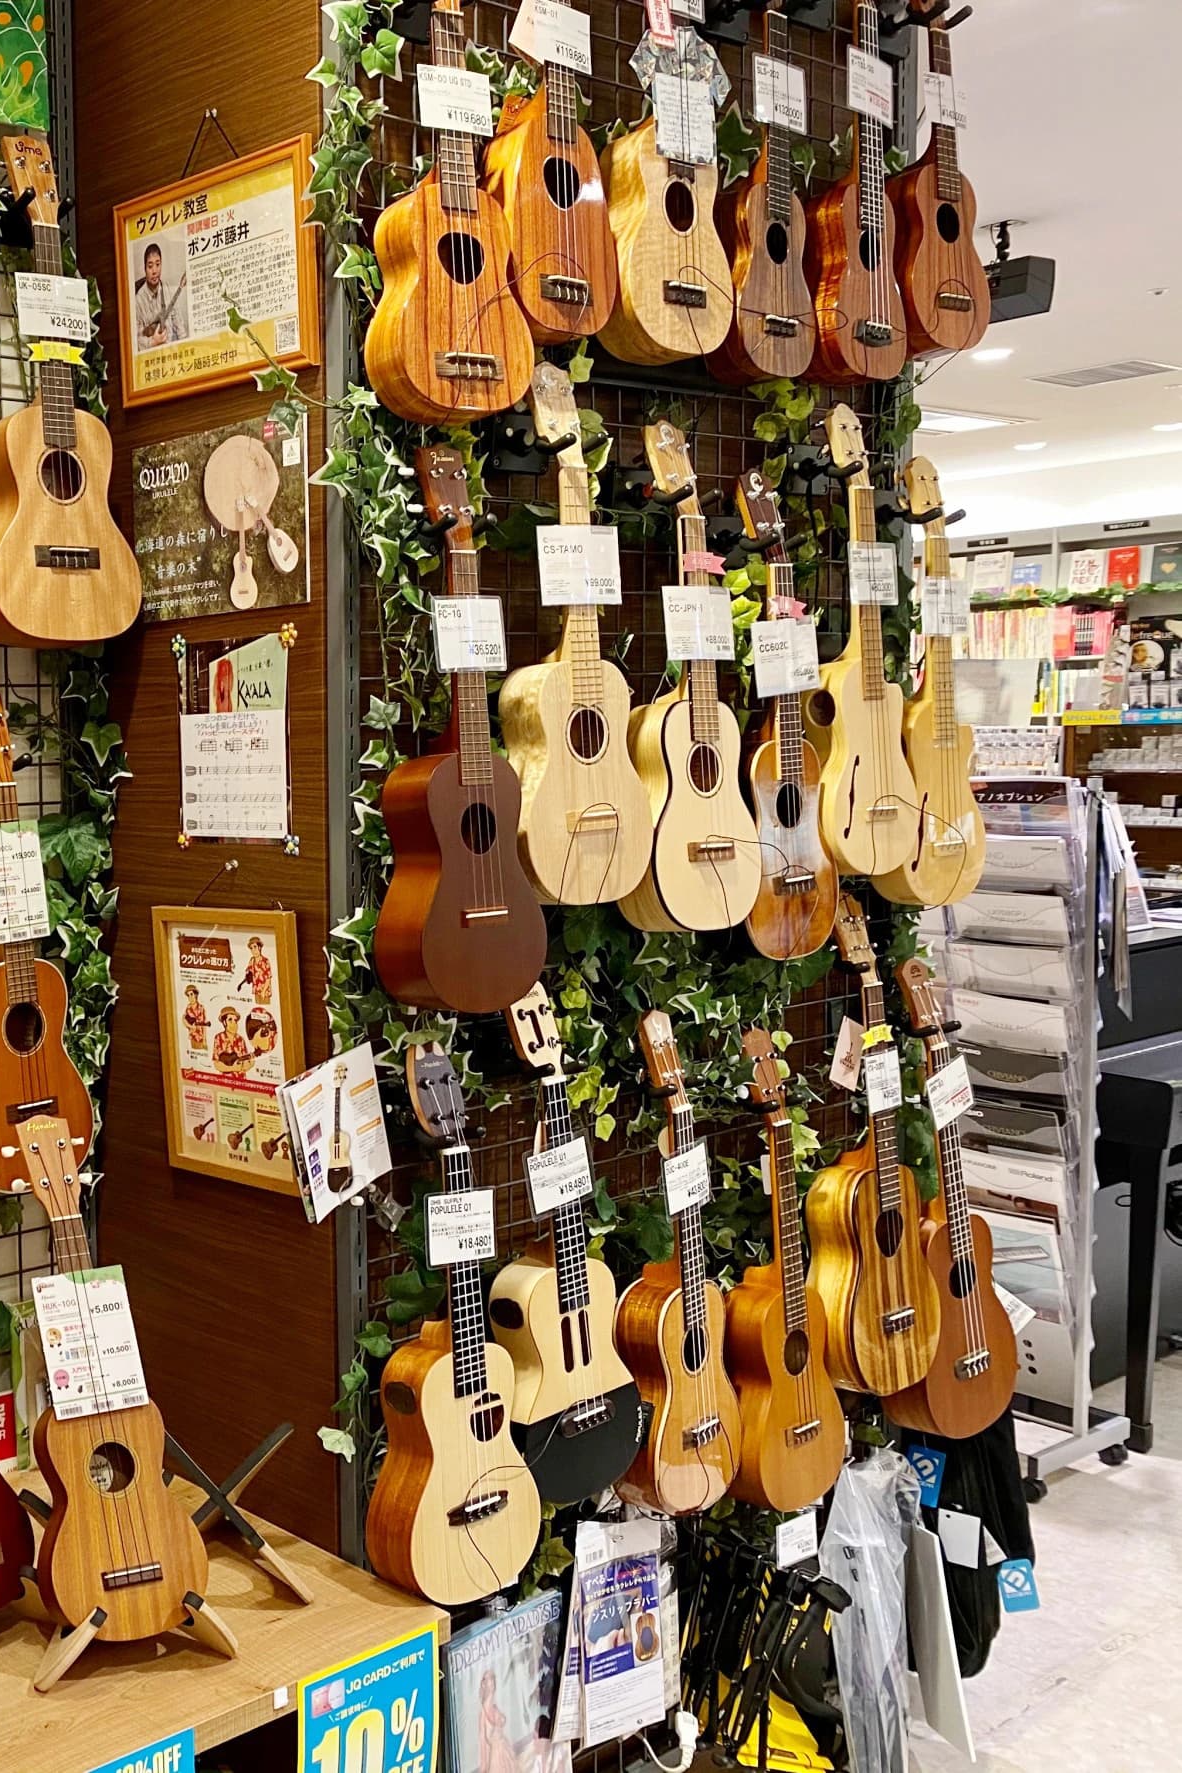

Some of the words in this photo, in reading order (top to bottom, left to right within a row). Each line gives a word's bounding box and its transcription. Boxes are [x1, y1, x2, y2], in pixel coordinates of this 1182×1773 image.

[136, 193, 209, 235] ウクレレ教室
[187, 221, 250, 257] ボンボ藤井
[450, 1632, 502, 1675] DREAMY
[503, 1599, 560, 1640] PARADISE
